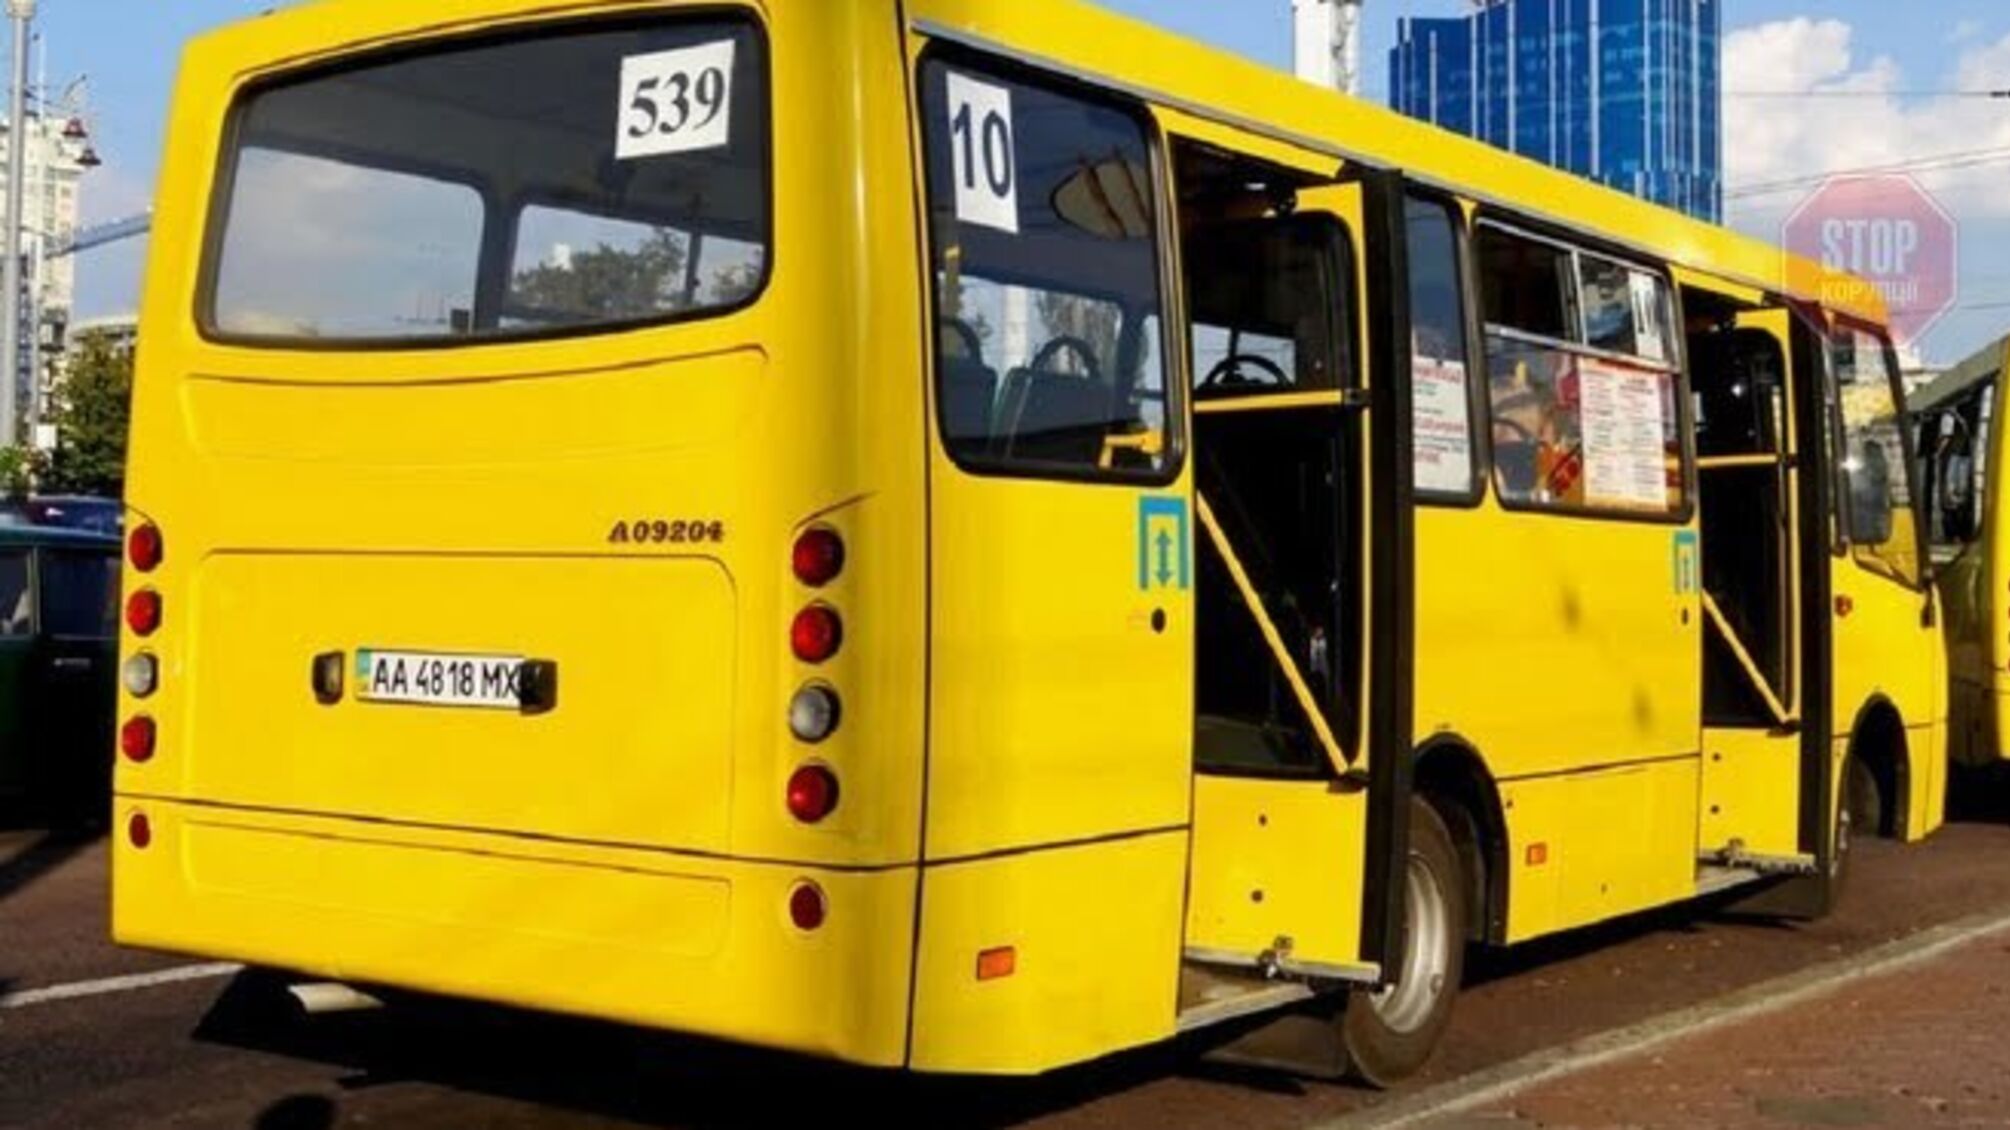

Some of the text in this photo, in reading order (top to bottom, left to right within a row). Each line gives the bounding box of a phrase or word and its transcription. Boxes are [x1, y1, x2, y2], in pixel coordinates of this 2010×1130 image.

[628, 67, 725, 138] 539
[953, 102, 1012, 198] 10
[608, 520, 724, 543] A09204
[373, 658, 522, 699] AA 4818 MX
